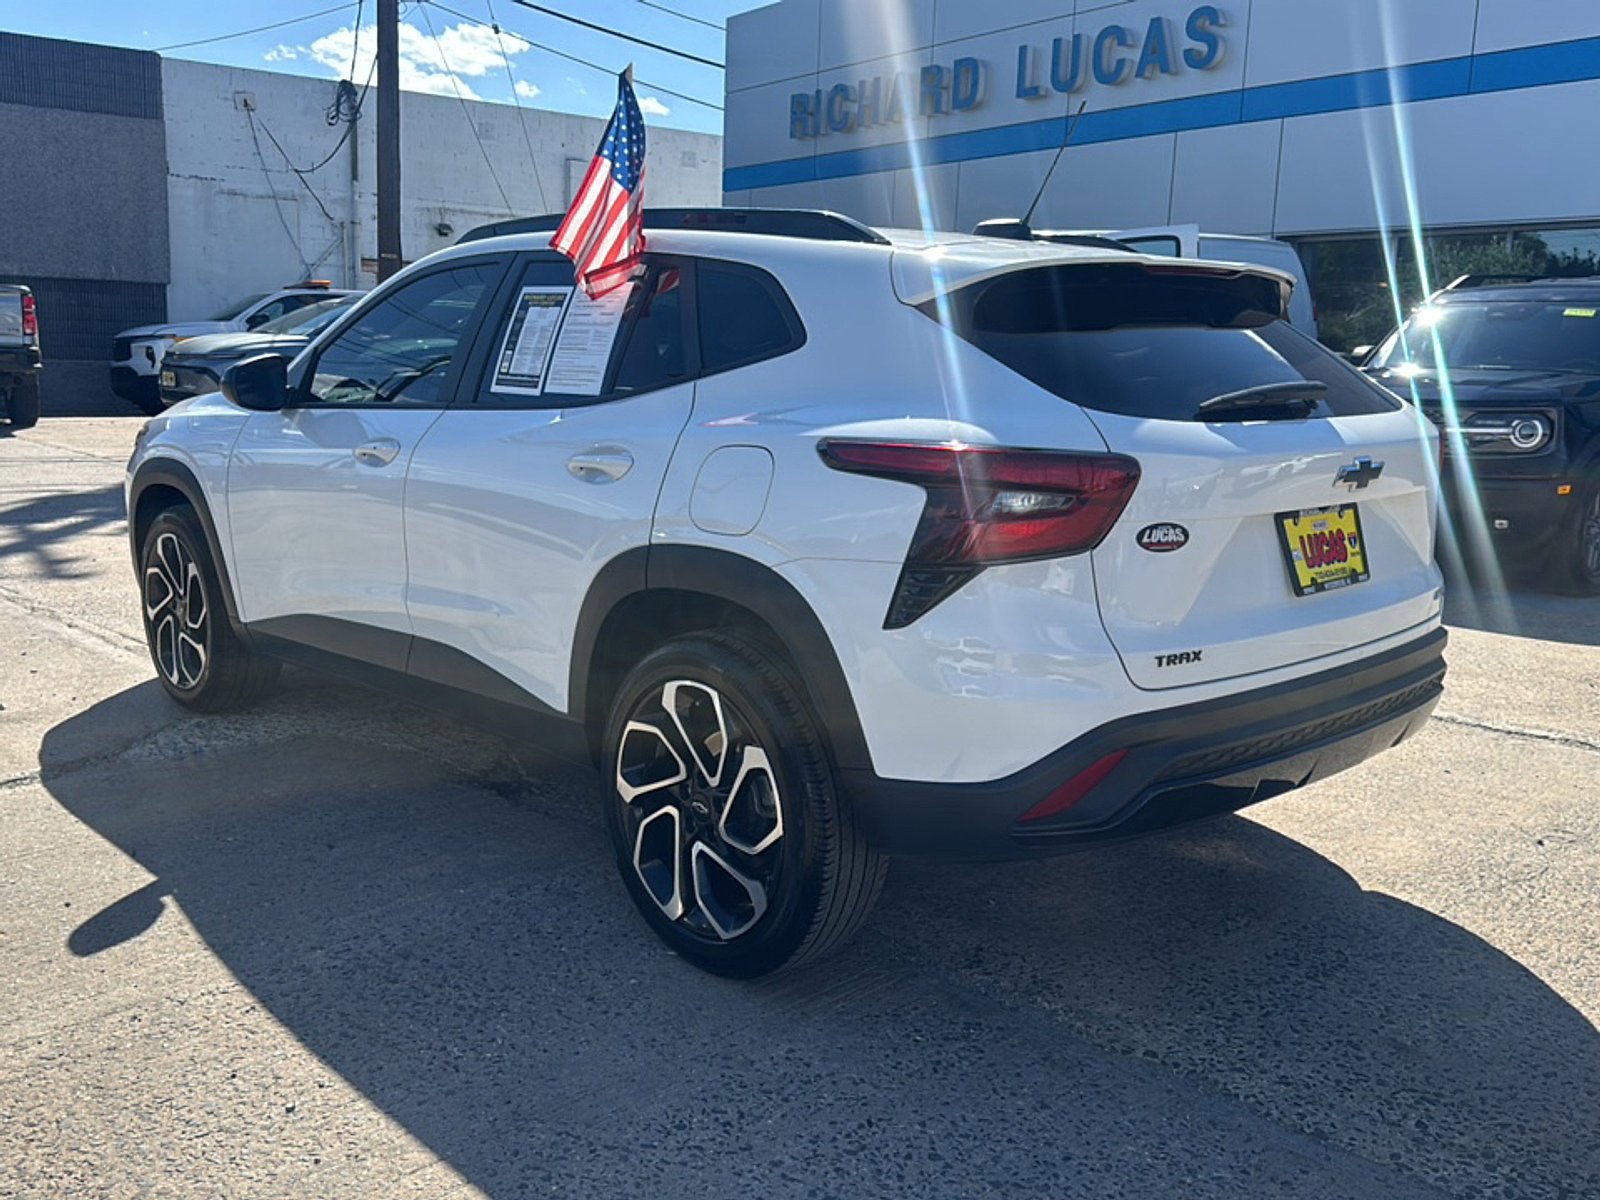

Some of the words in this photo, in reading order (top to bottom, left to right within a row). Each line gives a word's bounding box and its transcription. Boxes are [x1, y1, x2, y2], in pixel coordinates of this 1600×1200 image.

[789, 57, 983, 139] RICHARD
[1016, 5, 1224, 99] LUCAS
[1141, 527, 1185, 543] LUCAS
[1299, 528, 1348, 569] LUCAS
[1154, 649, 1203, 668] TRAX
